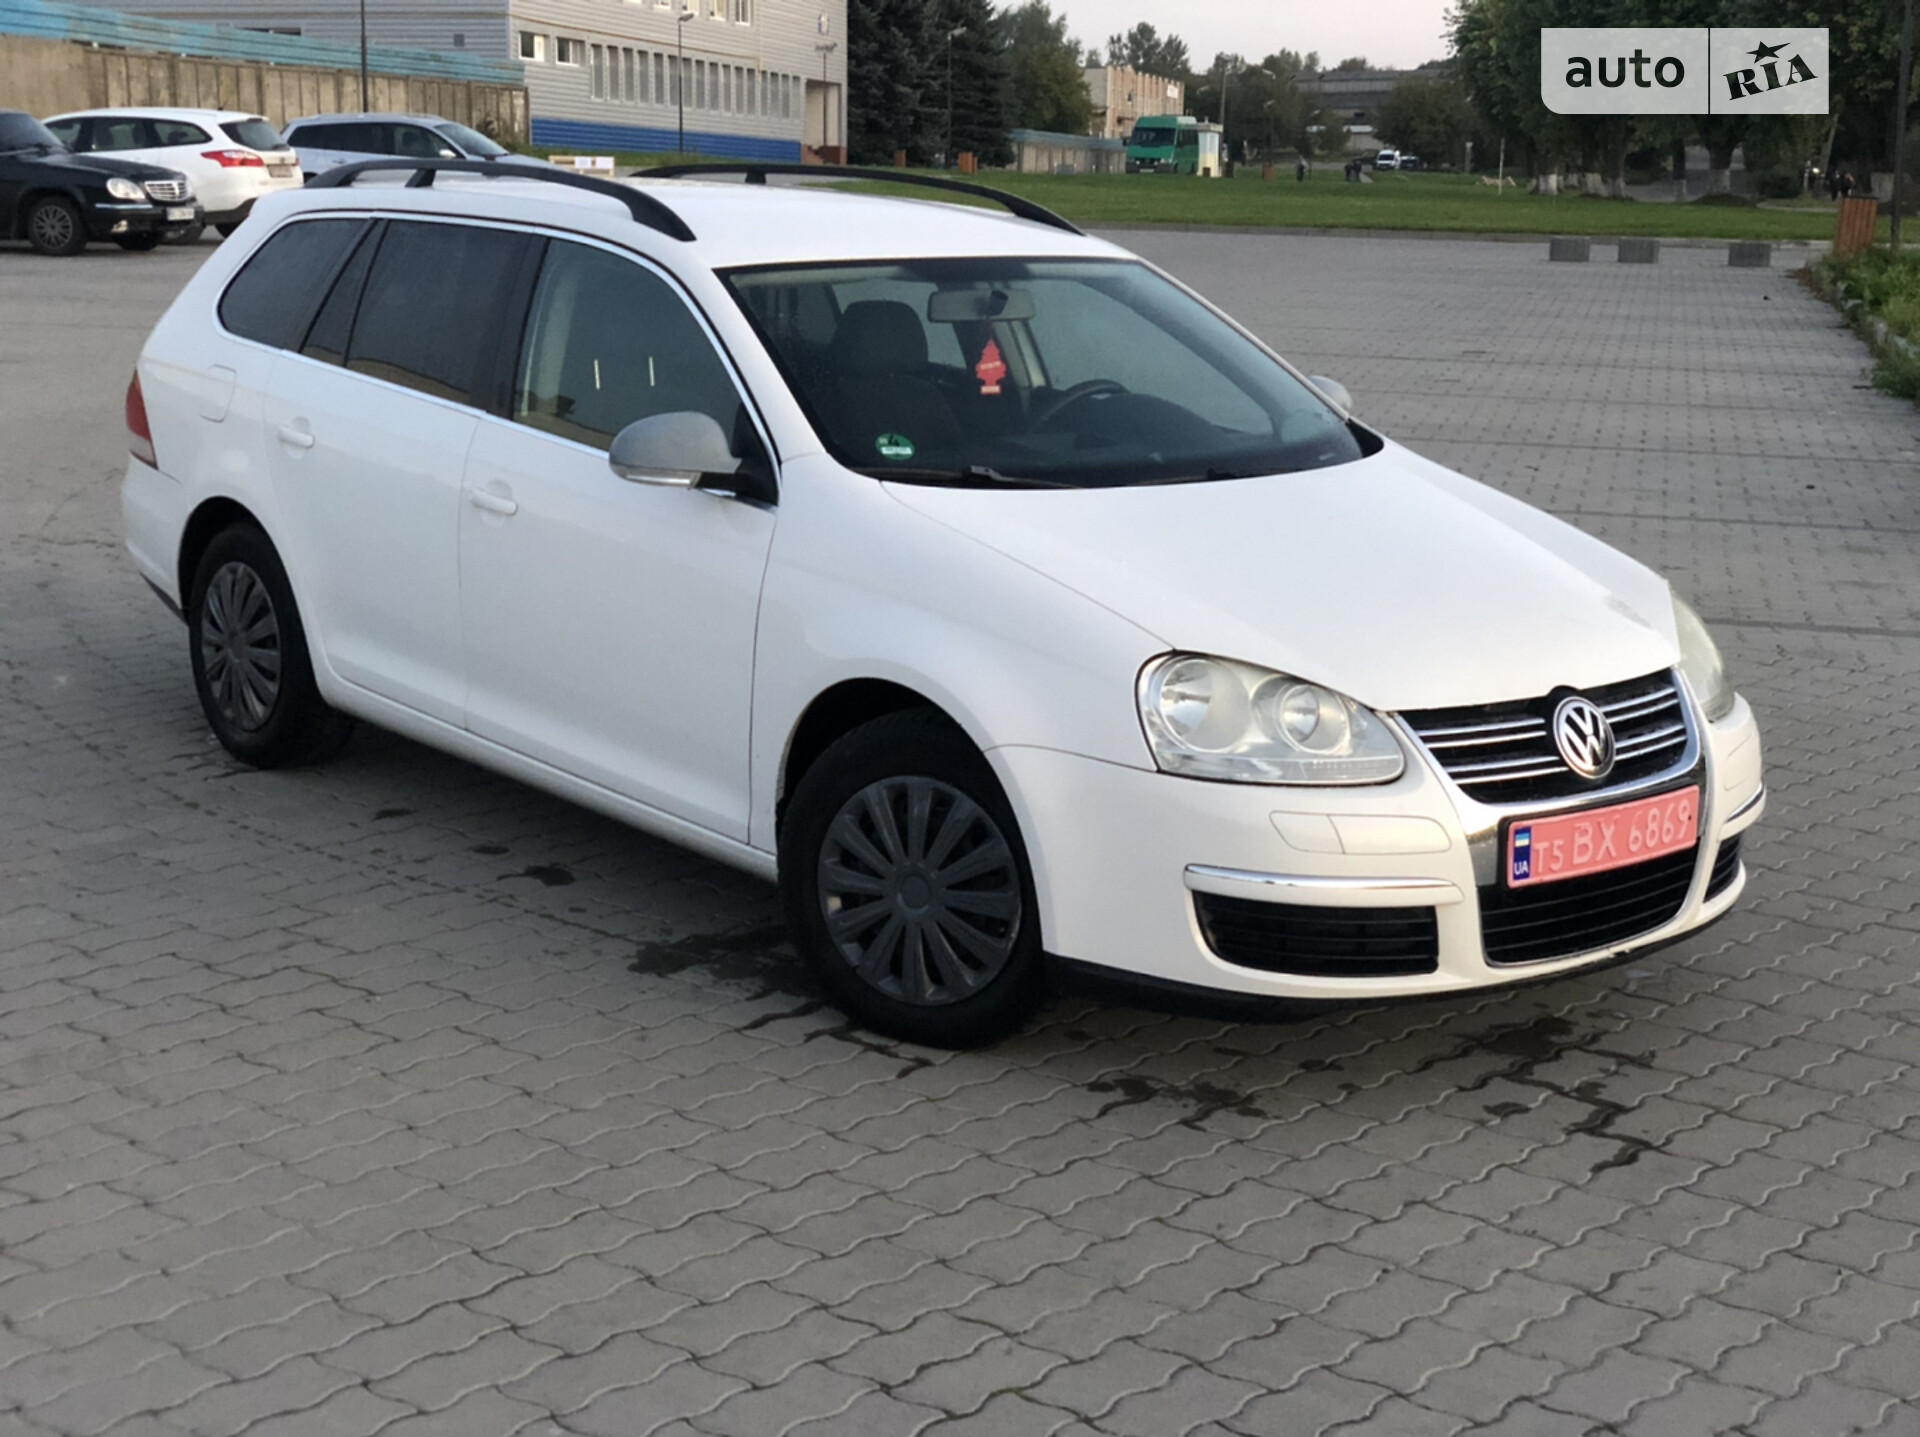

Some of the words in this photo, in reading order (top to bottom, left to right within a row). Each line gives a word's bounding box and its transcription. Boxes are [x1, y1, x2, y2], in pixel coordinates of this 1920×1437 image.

[1533, 839, 1564, 874] T5
[1572, 818, 1619, 865] BX
[1628, 798, 1691, 853] 6869
[1513, 860, 1530, 876] UA
